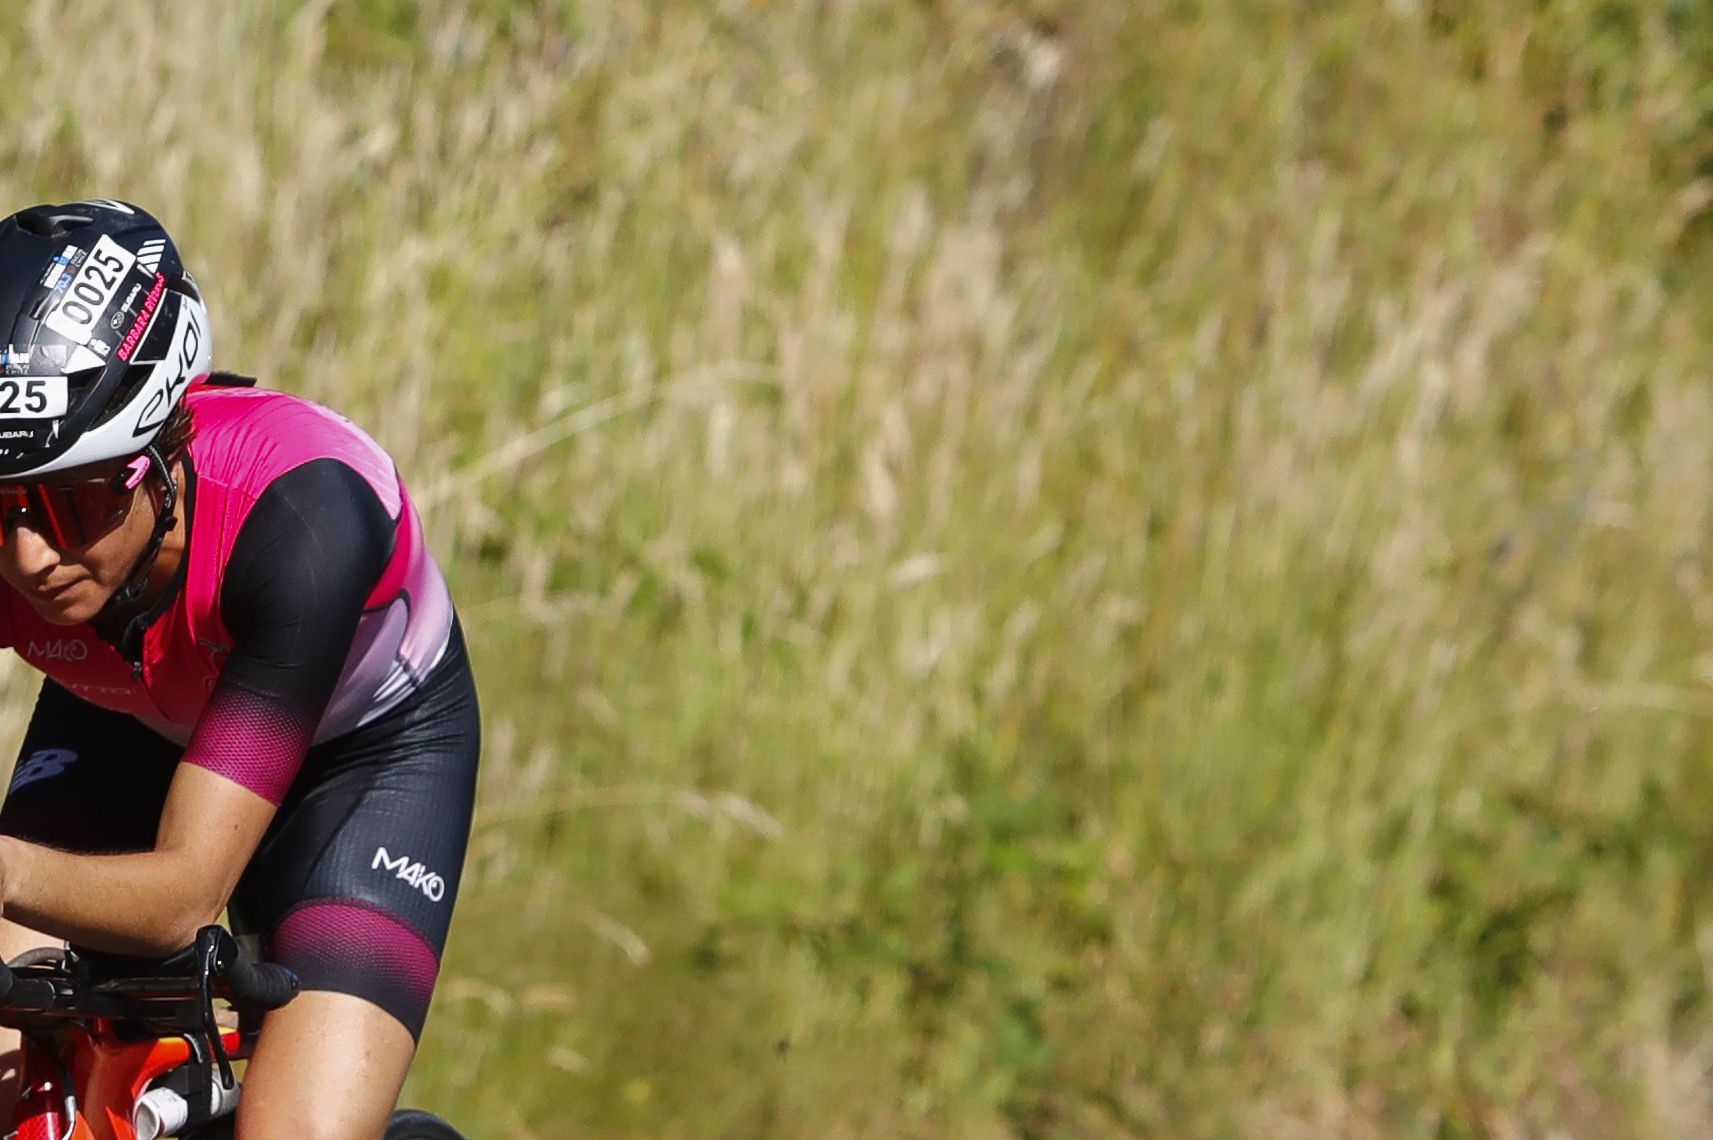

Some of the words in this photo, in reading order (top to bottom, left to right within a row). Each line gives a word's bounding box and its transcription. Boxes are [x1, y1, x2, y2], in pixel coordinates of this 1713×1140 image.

[62, 248, 124, 325] 0025
[117, 309, 150, 361] BARBARA
[371, 846, 445, 902] MAKO
